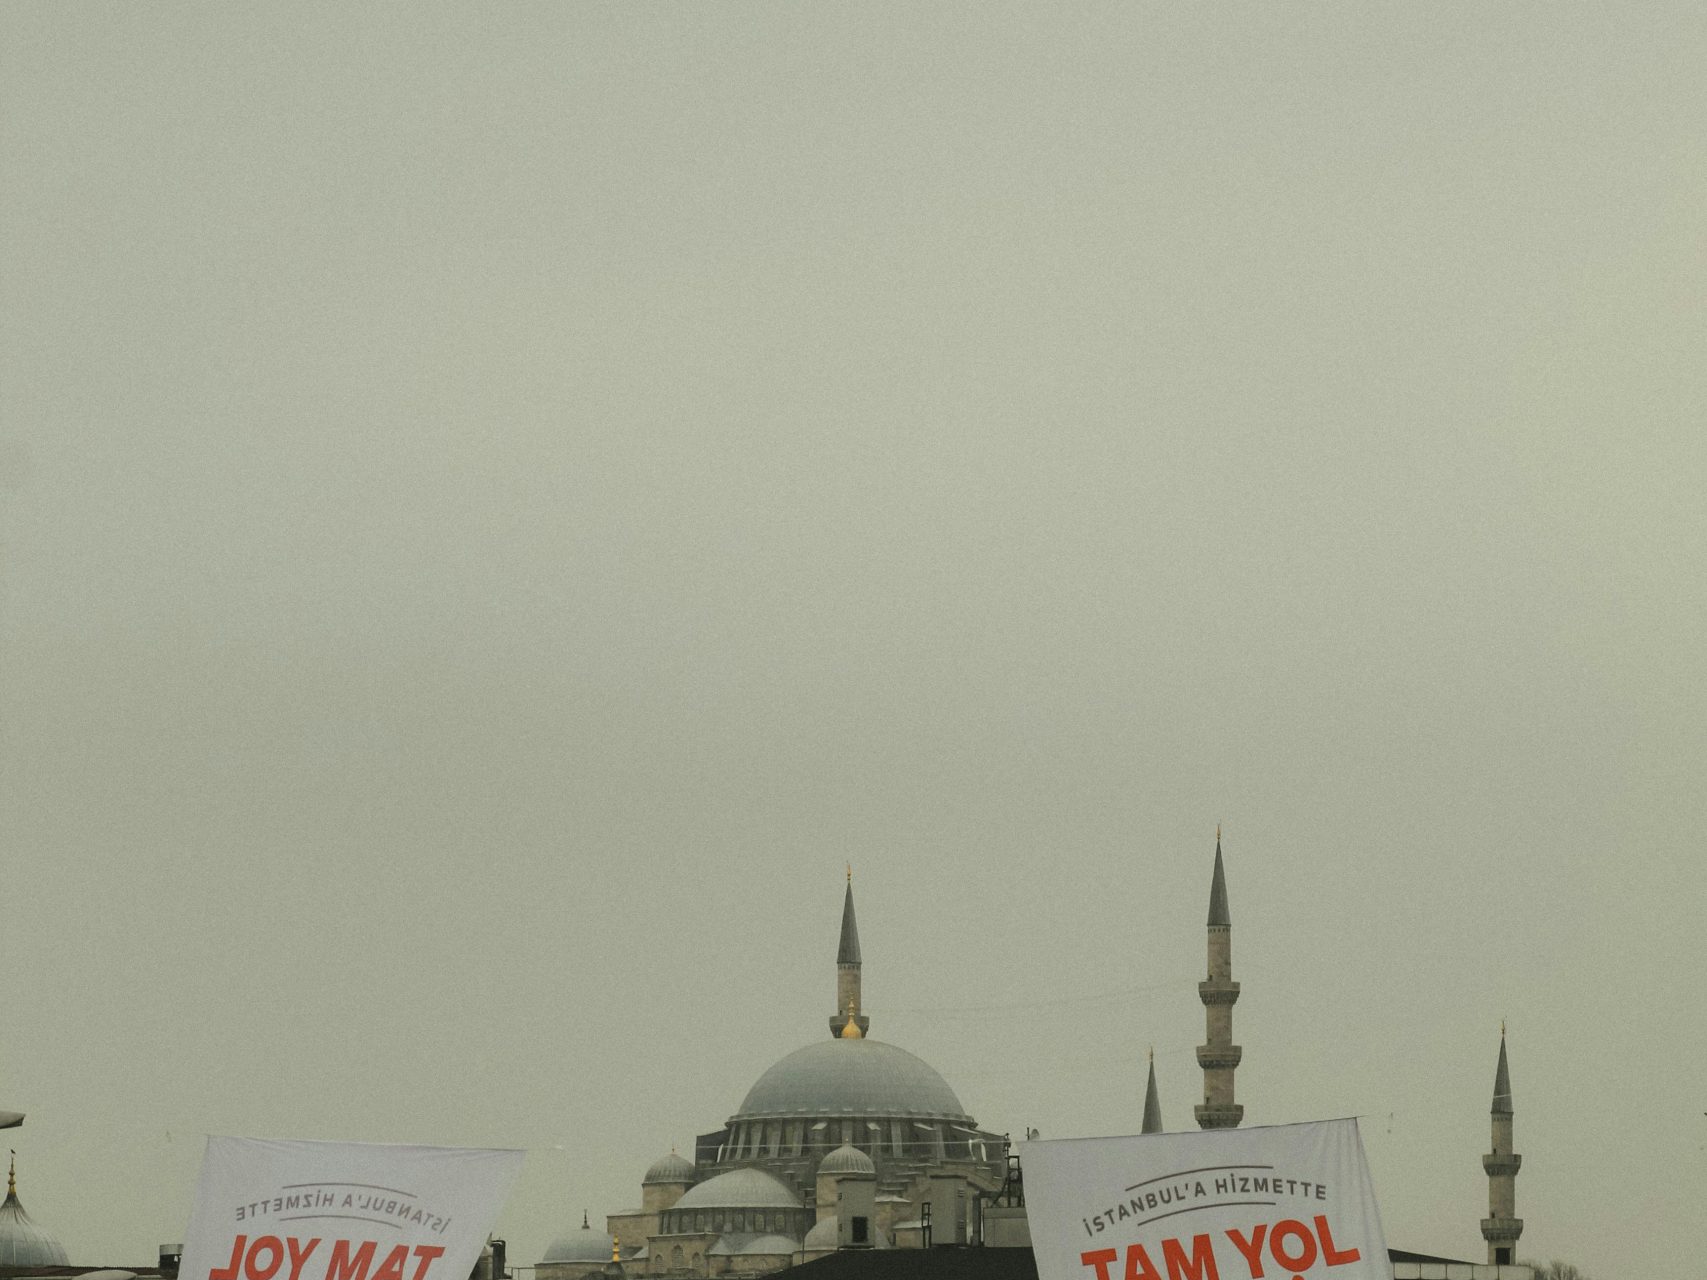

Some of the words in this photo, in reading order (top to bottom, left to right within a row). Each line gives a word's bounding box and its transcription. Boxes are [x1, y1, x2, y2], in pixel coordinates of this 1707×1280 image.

[1082, 1181, 1207, 1237] İSTANBUL'A
[1215, 1173, 1327, 1201] HİZMETTE
[1224, 1215, 1361, 1280] YOL
